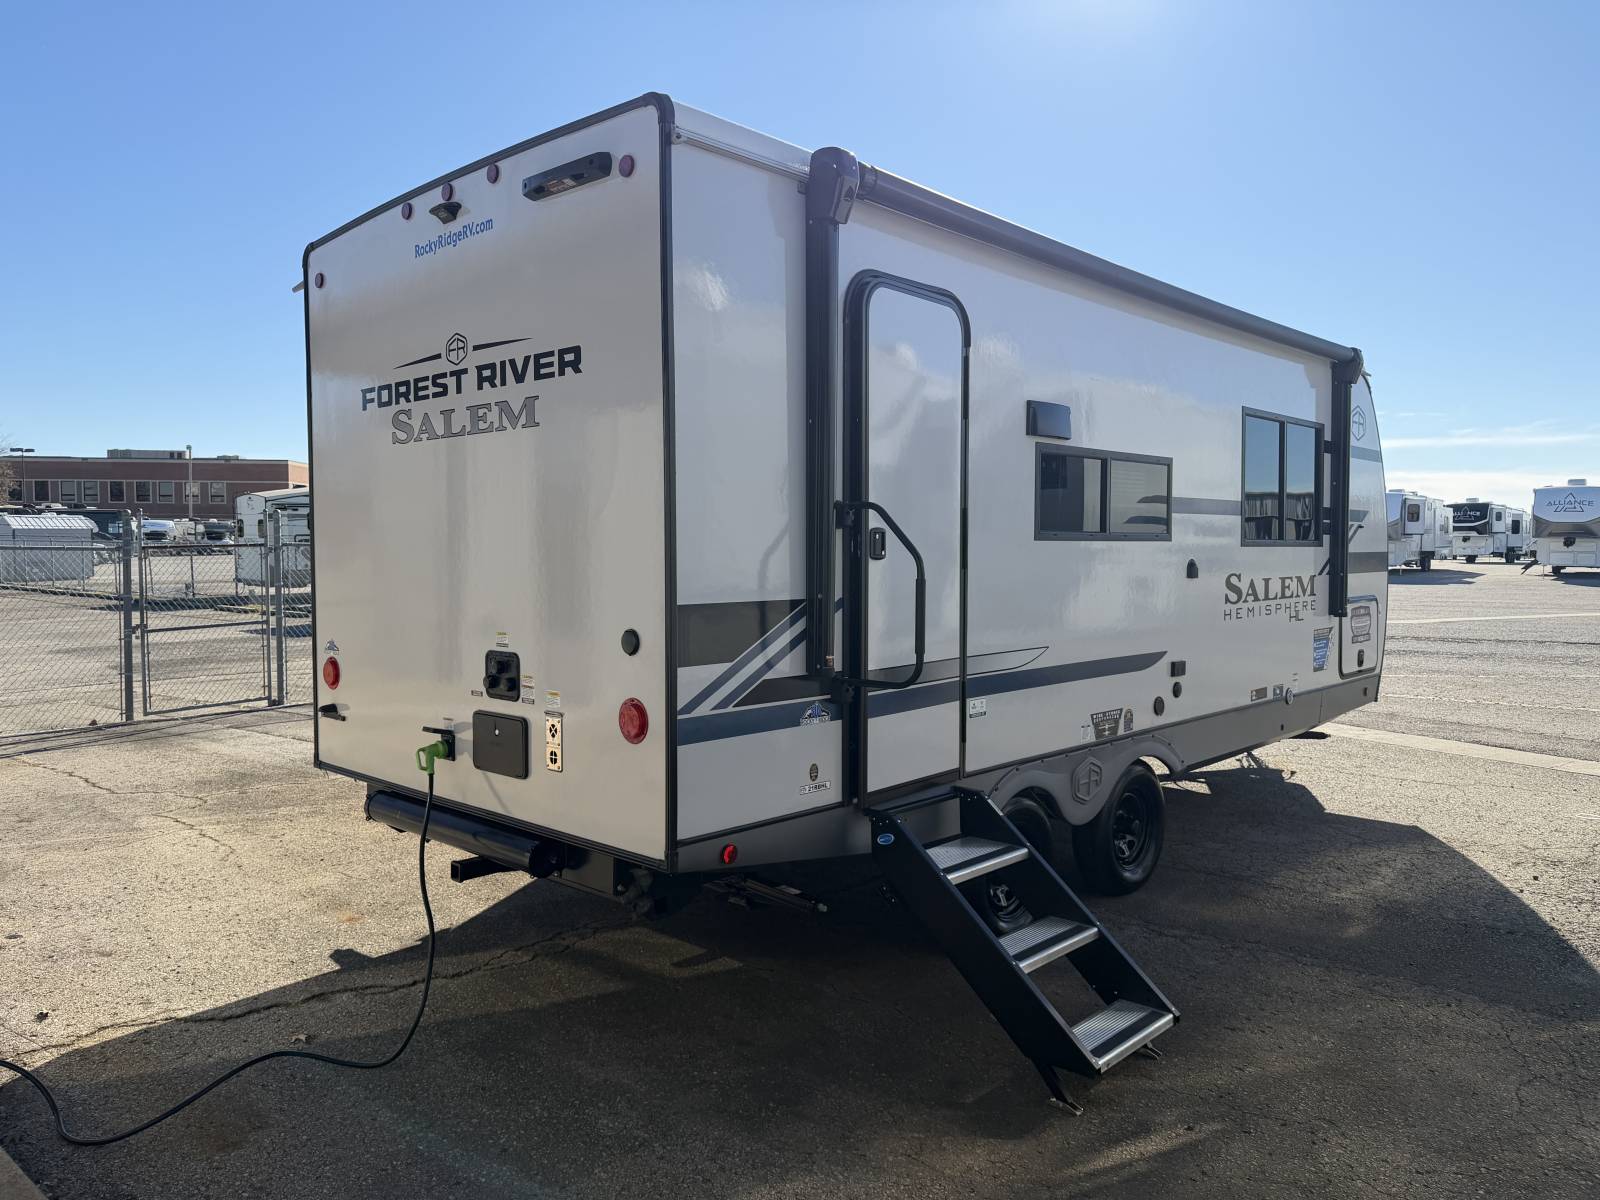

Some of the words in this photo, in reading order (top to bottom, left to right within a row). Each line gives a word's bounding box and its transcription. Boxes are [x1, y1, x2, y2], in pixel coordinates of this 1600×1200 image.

[414, 219, 494, 258] RockyRidgeRV.com
[360, 367, 469, 411] FOREST
[474, 345, 583, 391] RIVER
[391, 395, 541, 445] SALEM
[1546, 499, 1595, 507] ALLIANCE
[1224, 572, 1317, 605] SALEM
[1223, 599, 1317, 621] HEMISPHERE
